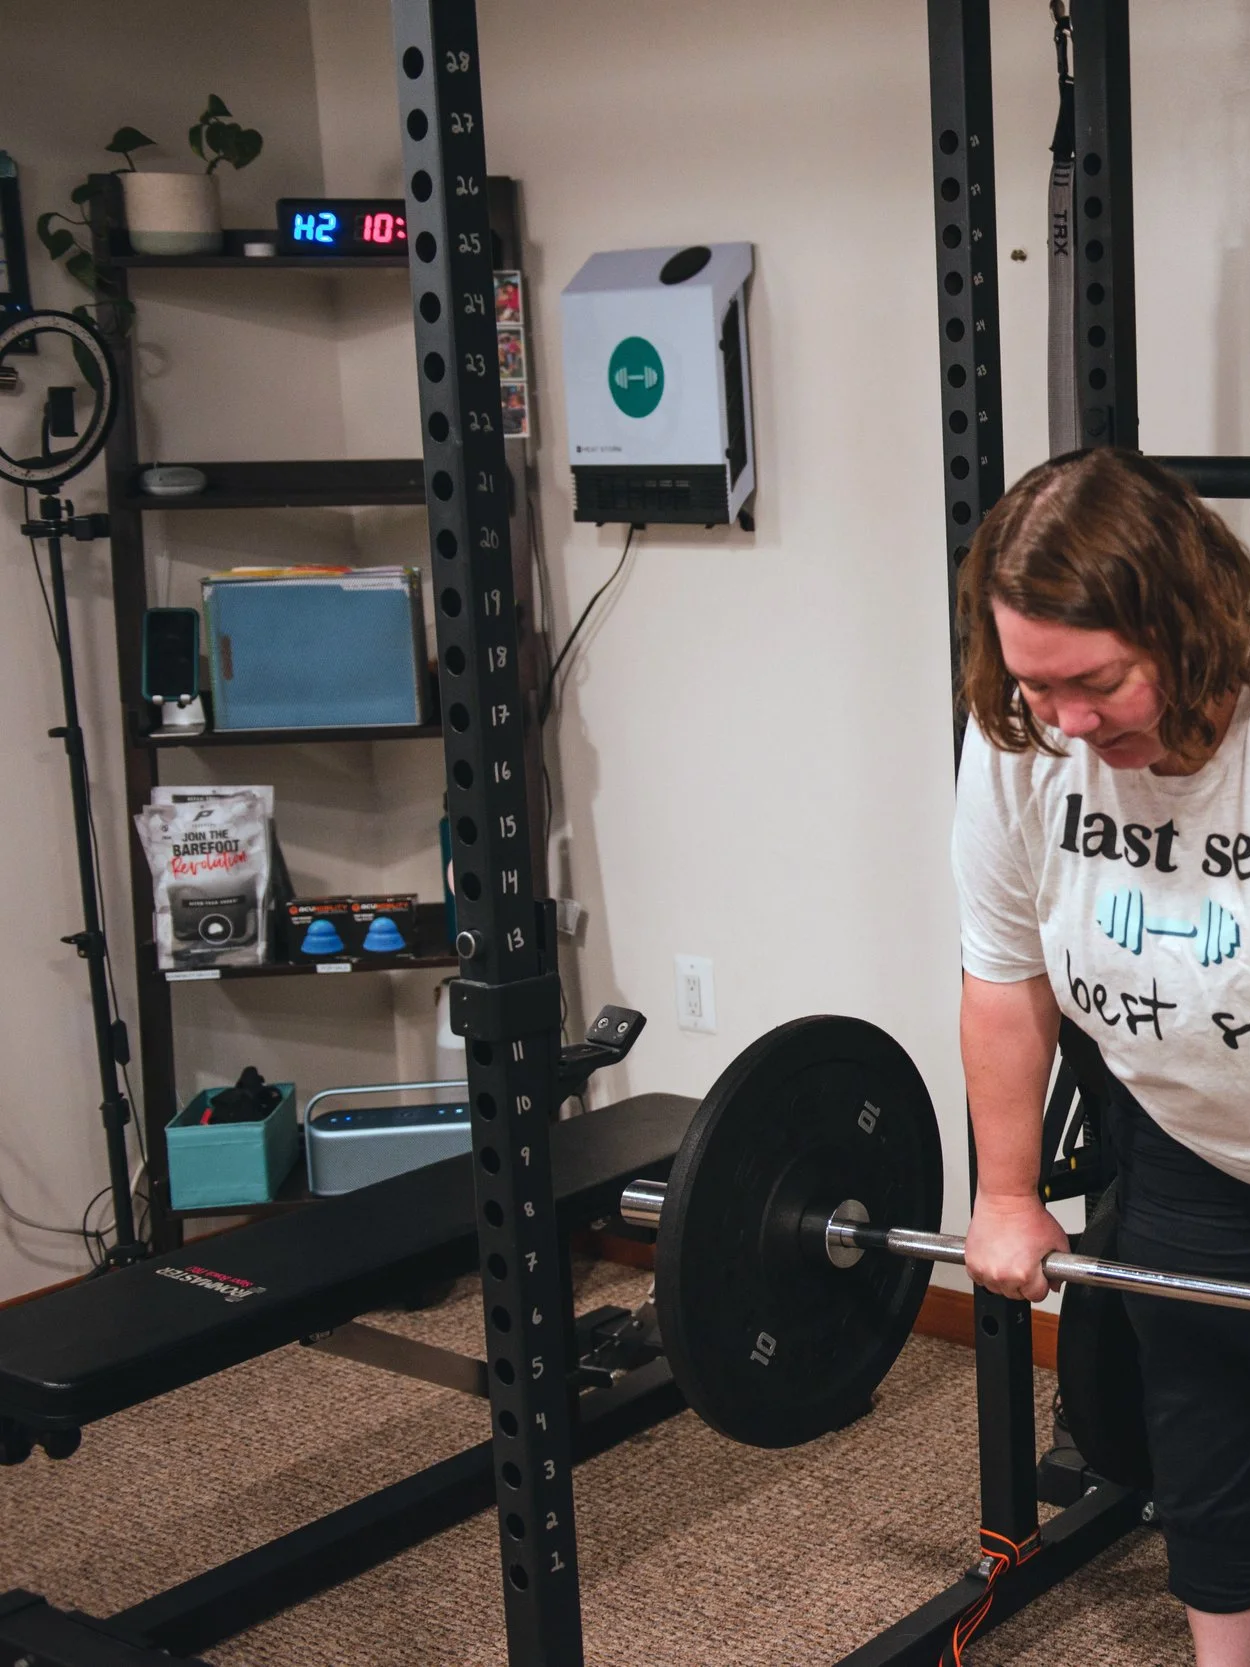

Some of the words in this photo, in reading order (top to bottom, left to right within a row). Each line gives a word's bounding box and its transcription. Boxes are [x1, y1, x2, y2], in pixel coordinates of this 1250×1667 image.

[446, 50, 470, 74] 28
[451, 112, 474, 134] 27
[455, 175, 479, 196] 26
[458, 232, 482, 255] 25
[1053, 209, 1069, 256] TRX
[463, 292, 486, 316] 24
[465, 353, 486, 377] 23
[468, 410, 494, 433] 22
[477, 471, 494, 493] 21
[479, 526, 499, 549] 20
[484, 588, 501, 616] 19
[488, 645, 508, 673] 18
[491, 704, 510, 727] 17
[494, 761, 512, 784] 16
[181, 831, 206, 842] JOIN
[209, 829, 229, 840] THE
[499, 814, 517, 838] 15
[1060, 793, 1179, 873] last
[172, 839, 240, 857] BAREFOOT
[171, 851, 248, 879] Revolution
[501, 869, 518, 895] 14
[507, 927, 525, 952] 13
[1066, 949, 1177, 1040] best
[512, 1040, 524, 1062] 11
[516, 1095, 532, 1115] 10
[857, 1100, 881, 1135] 10
[520, 1146, 530, 1167] 9
[523, 1201, 536, 1218] 8
[524, 1251, 538, 1273] 7
[155, 1267, 255, 1298] IRONMASTER
[531, 1307, 543, 1325] 6
[750, 1331, 777, 1366] 10
[531, 1355, 544, 1380] 5
[535, 1412, 547, 1431] 4
[543, 1459, 556, 1480] 3
[545, 1511, 559, 1530] 2
[550, 1551, 565, 1573] 1
